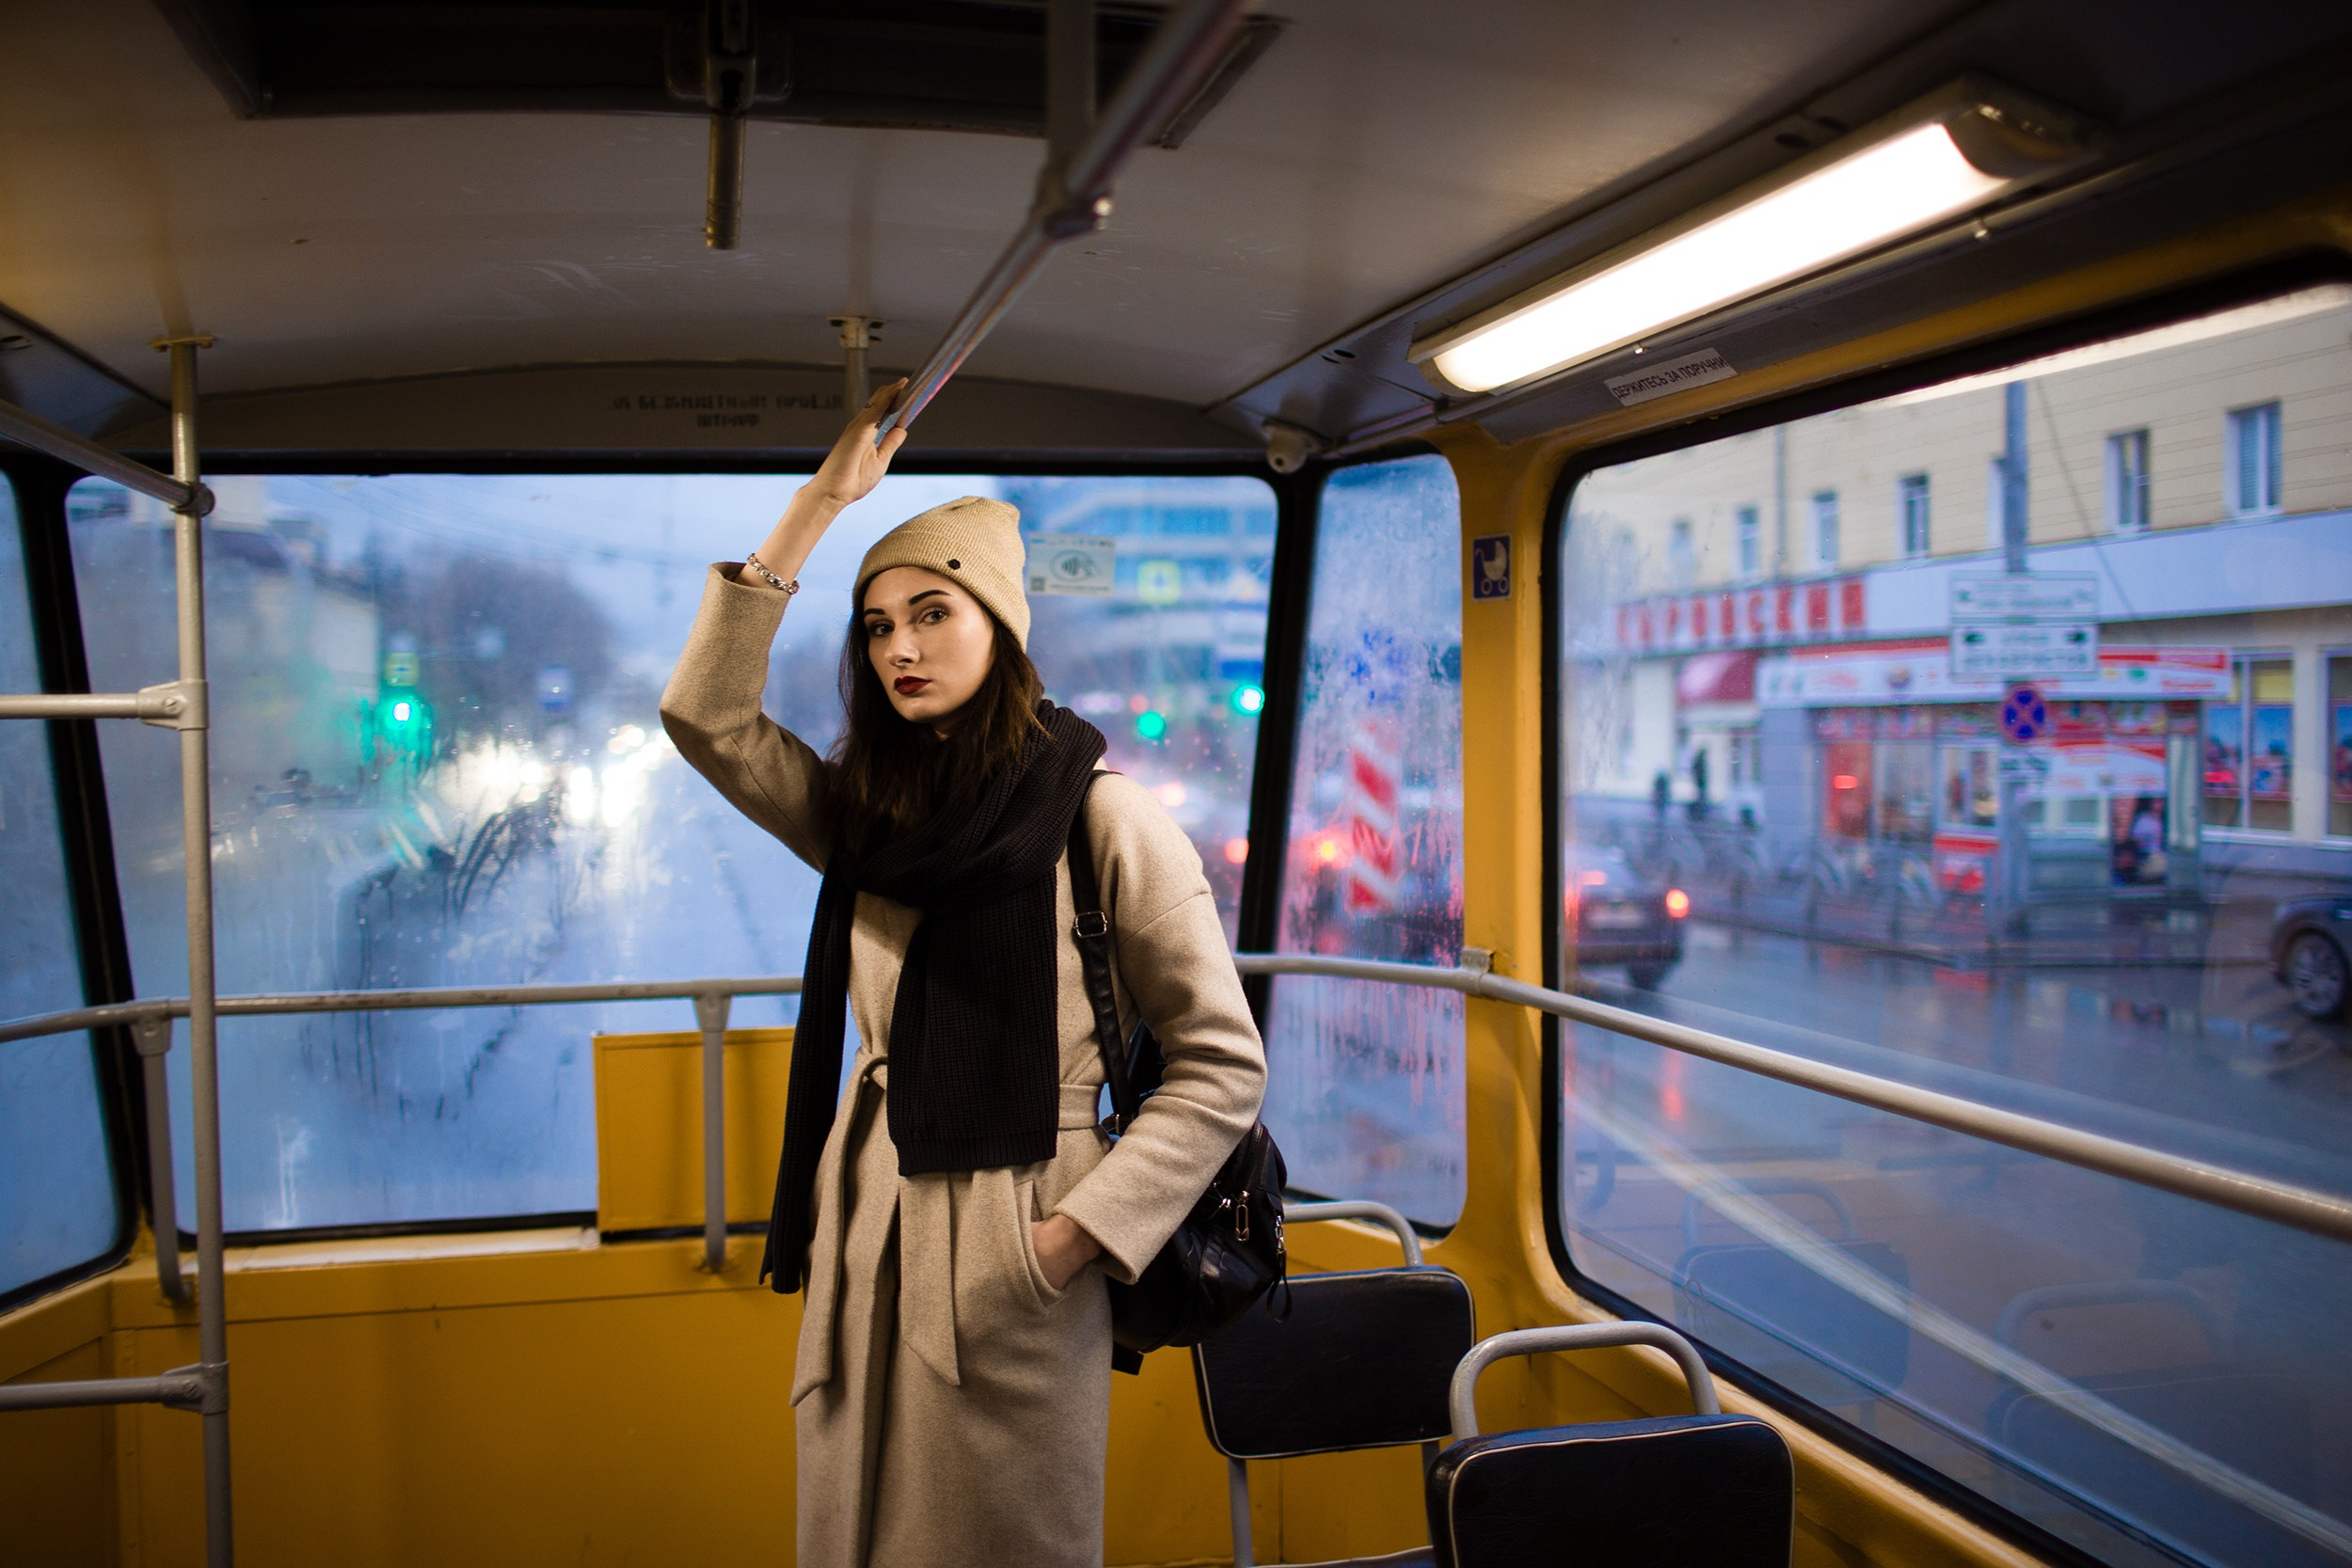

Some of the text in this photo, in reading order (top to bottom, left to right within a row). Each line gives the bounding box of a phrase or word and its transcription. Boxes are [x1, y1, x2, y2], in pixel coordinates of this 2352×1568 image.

[1612, 356, 1728, 399] ДЕРЖИТЕСЬ ЗА ПОРУЧНИ
